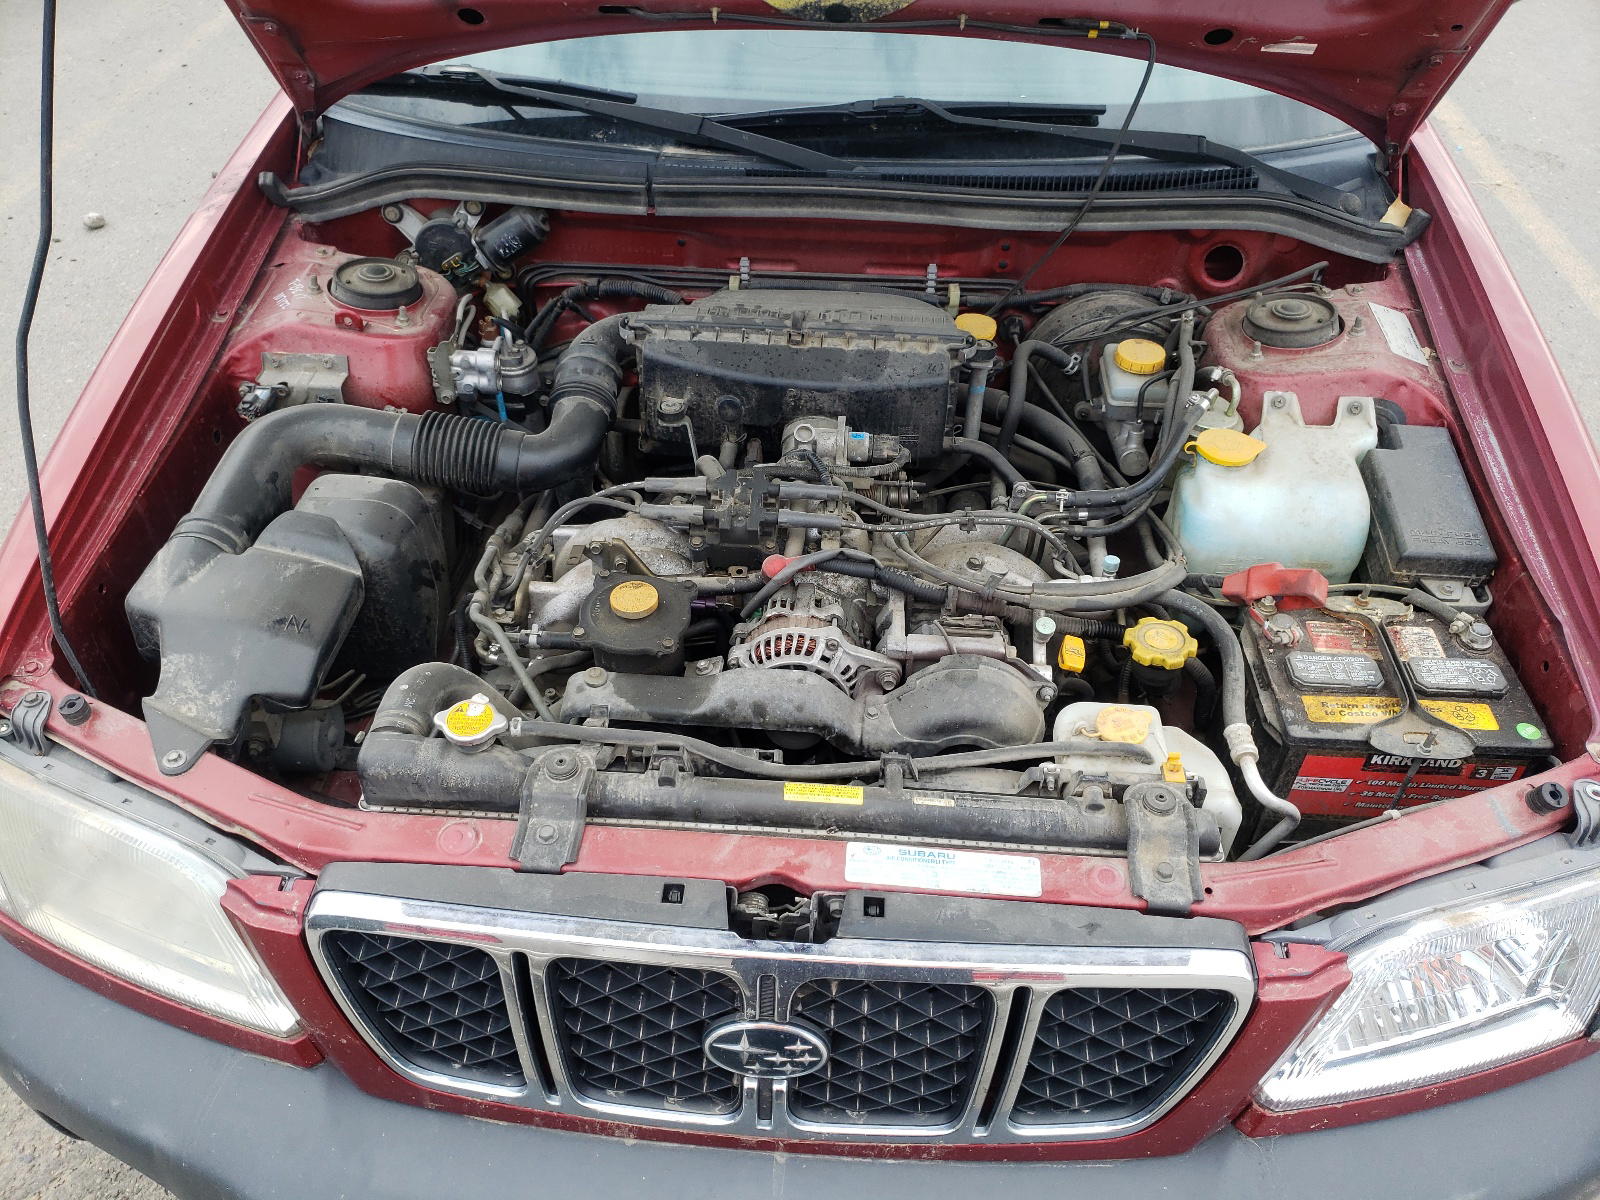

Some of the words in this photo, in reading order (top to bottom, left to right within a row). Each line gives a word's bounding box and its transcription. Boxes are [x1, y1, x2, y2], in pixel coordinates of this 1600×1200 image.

[1321, 701, 1360, 709] Return
[1339, 710, 1379, 718] Costco
[1370, 754, 1462, 768] KIRKAND
[1475, 769, 1488, 778] 3
[1419, 782, 1457, 790] Limited
[898, 848, 956, 860] SUBARU
